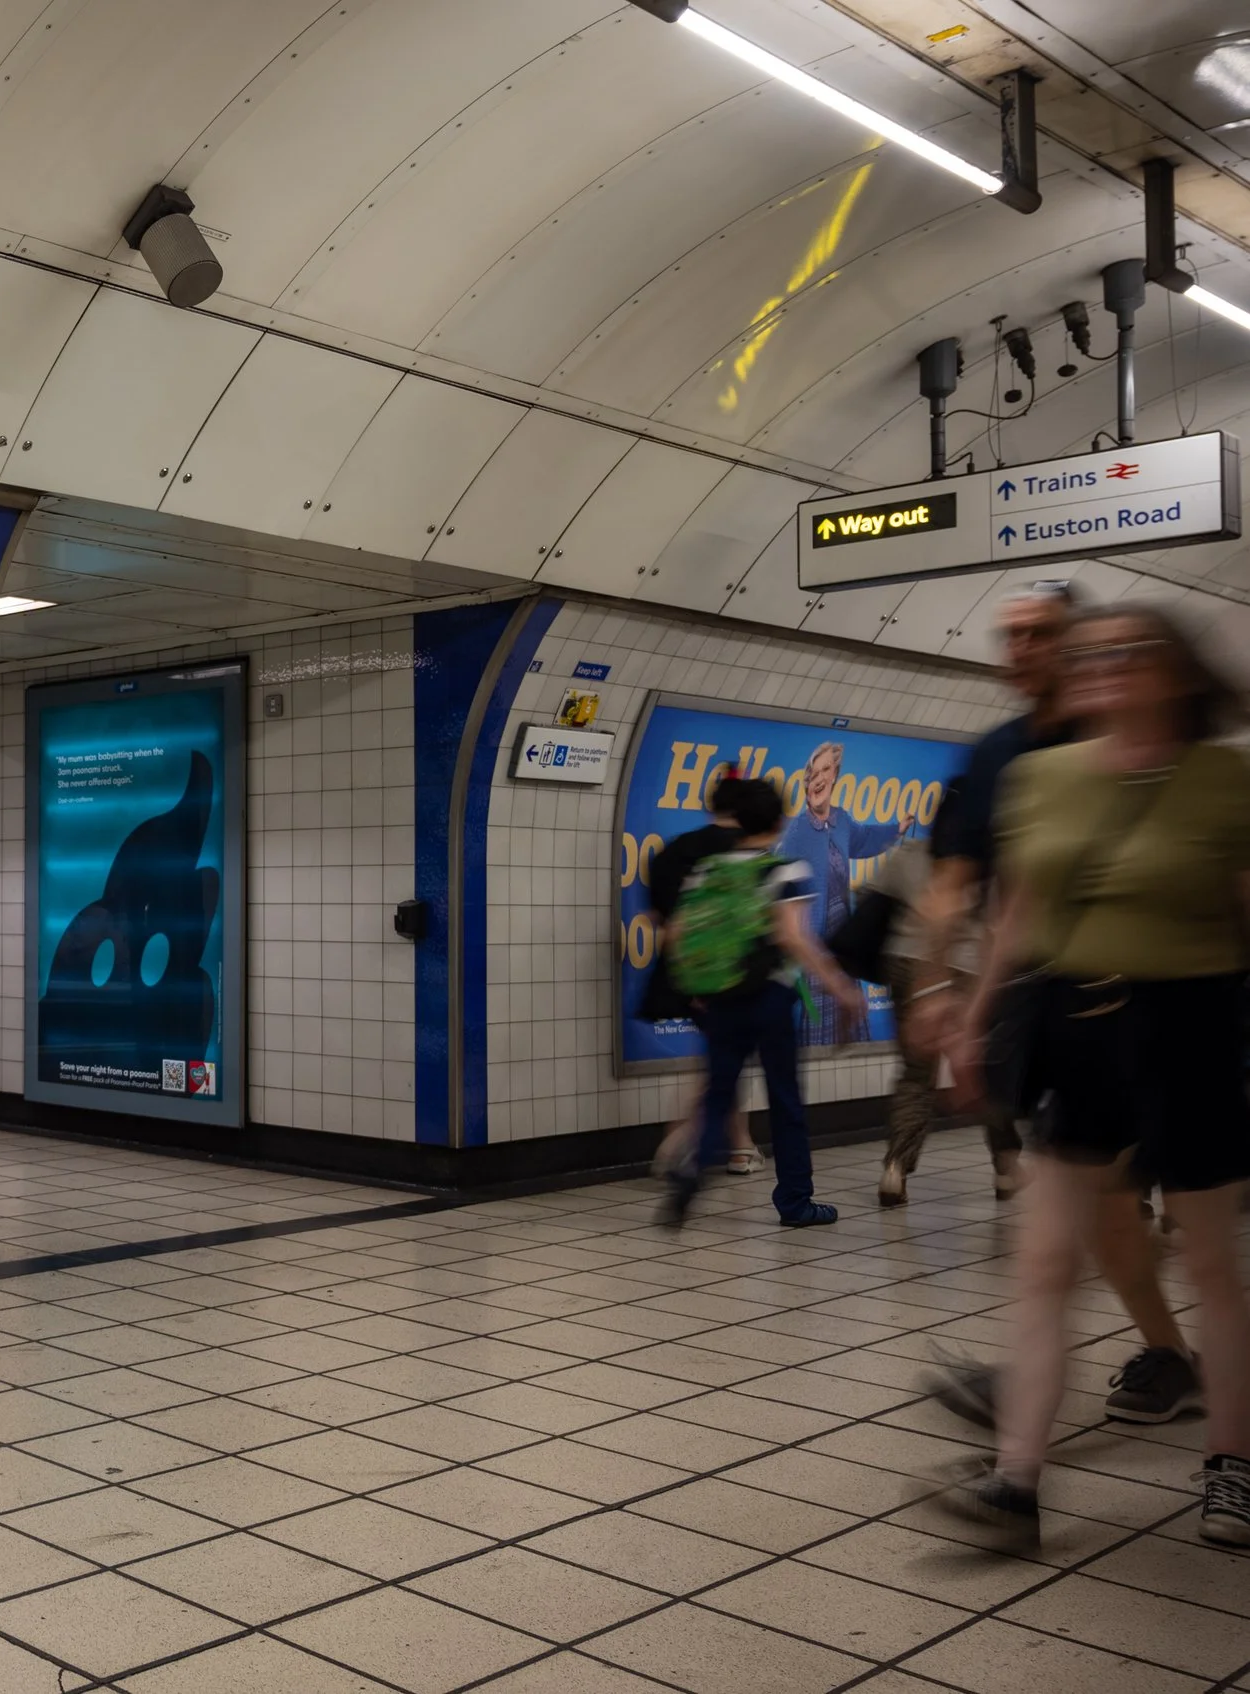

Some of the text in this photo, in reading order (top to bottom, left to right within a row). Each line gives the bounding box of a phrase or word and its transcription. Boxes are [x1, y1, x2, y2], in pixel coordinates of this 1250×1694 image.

[1023, 471, 1098, 496] Trains
[838, 505, 930, 536] Way out
[1024, 501, 1182, 541] Euston Road
[576, 665, 603, 677] Keep left
[98, 751, 133, 761] babysitting
[134, 748, 152, 757] when
[153, 747, 164, 756] the
[590, 748, 608, 756] platform
[72, 767, 100, 776] poonami
[58, 780, 70, 788] She
[70, 780, 88, 788] never
[88, 777, 112, 787] offered
[654, 1025, 665, 1034] The
[665, 1024, 678, 1034] New
[60, 1061, 76, 1071] Save
[76, 1064, 90, 1073] your
[91, 1064, 107, 1075] night
[107, 1065, 123, 1076] from
[130, 1070, 159, 1080] poonami
